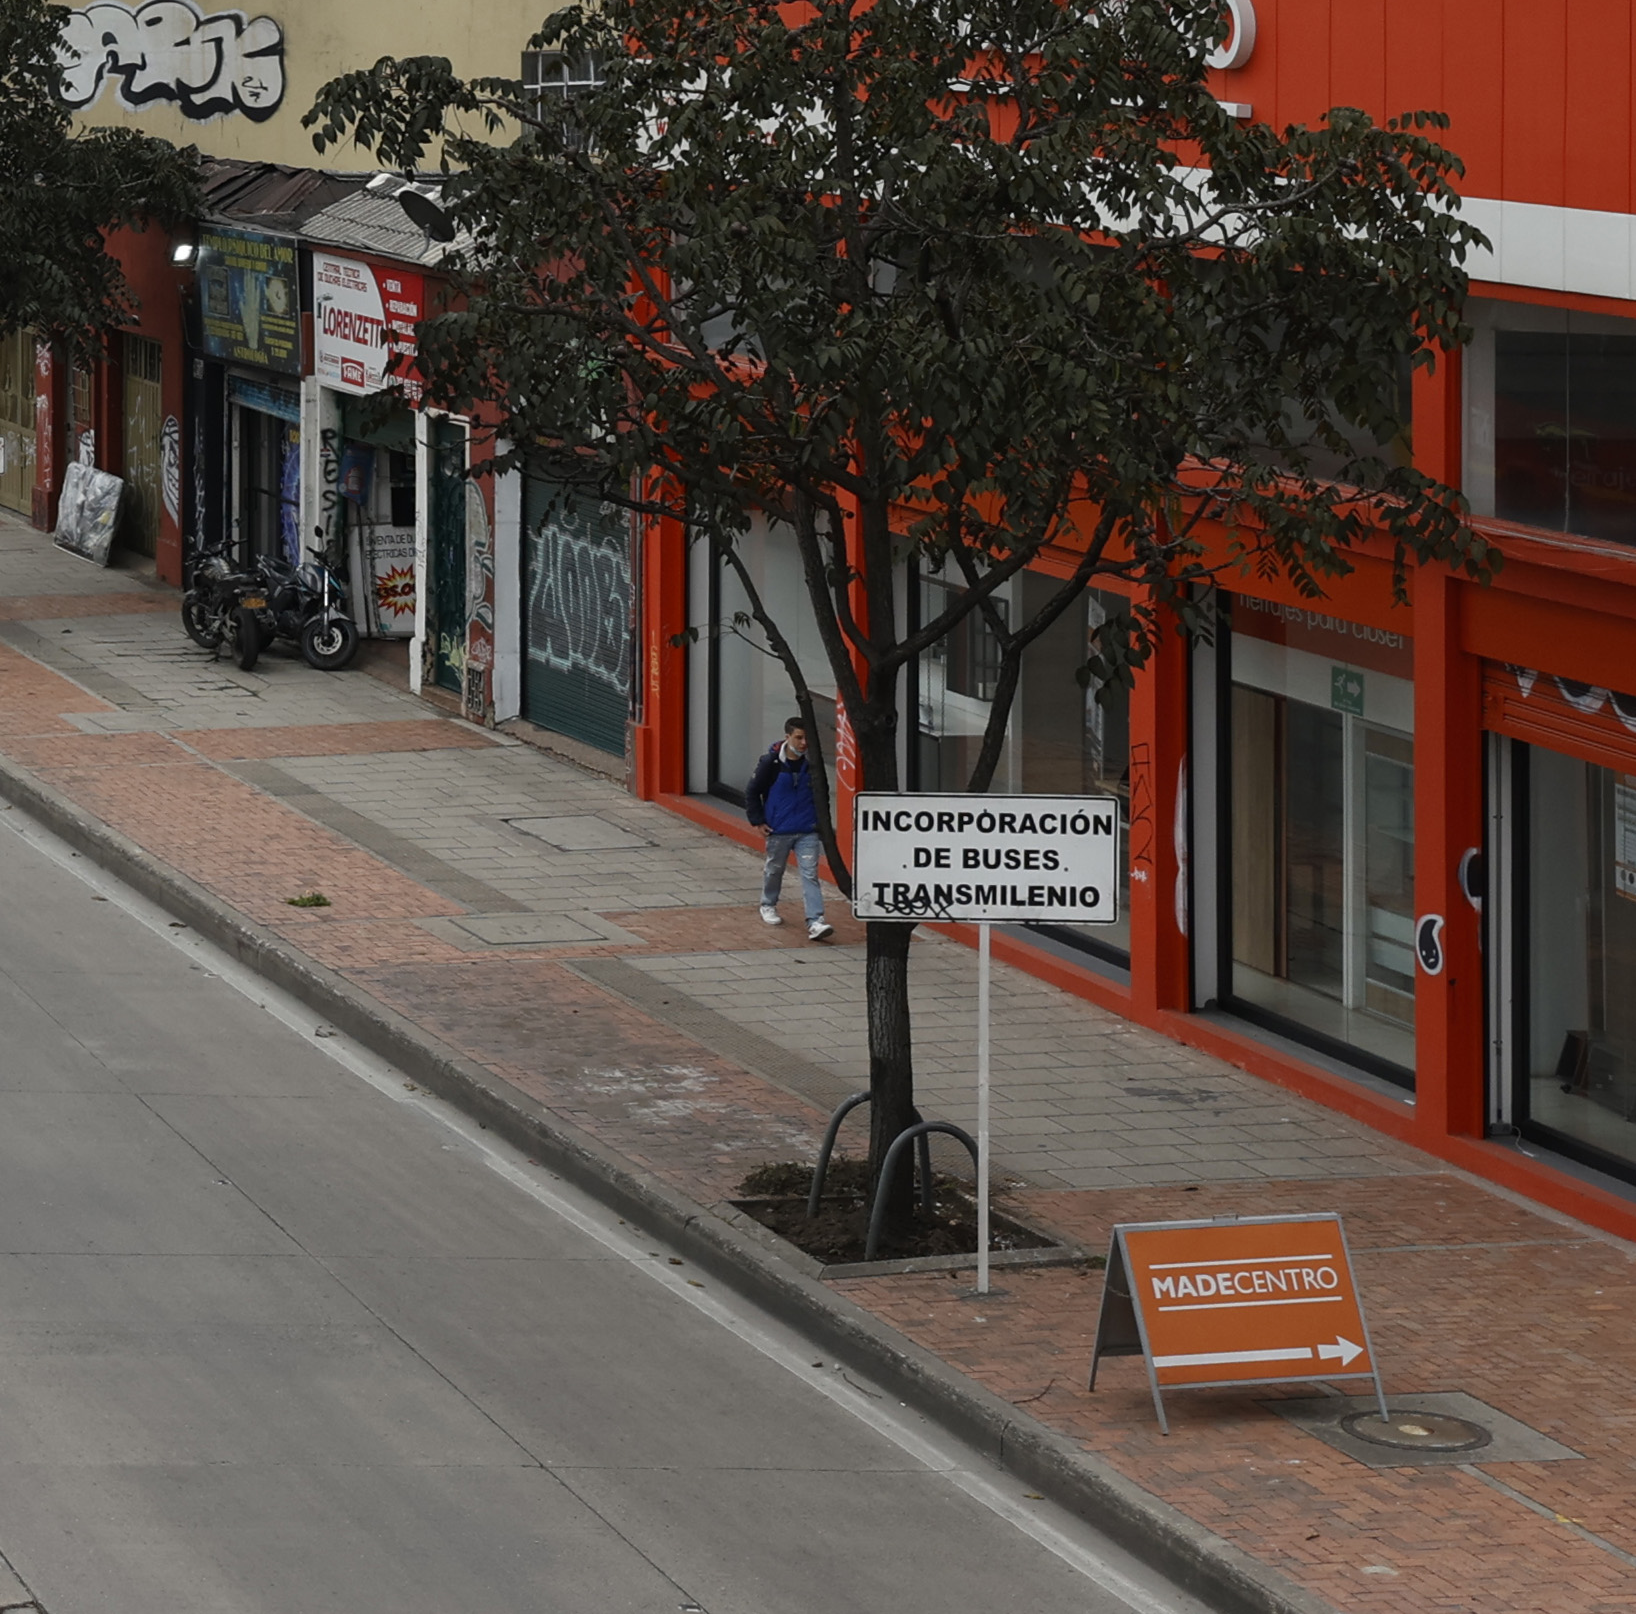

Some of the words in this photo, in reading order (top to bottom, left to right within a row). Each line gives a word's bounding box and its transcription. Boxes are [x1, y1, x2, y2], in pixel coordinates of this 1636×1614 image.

[343, 364, 363, 383] FAME
[862, 809, 1112, 835] INCORPORACIÓN
[913, 847, 951, 868] DE
[962, 848, 1060, 870] BUSES
[872, 882, 1100, 908] TRANSMILENIO
[1151, 1266, 1338, 1299] MADECENTRO
